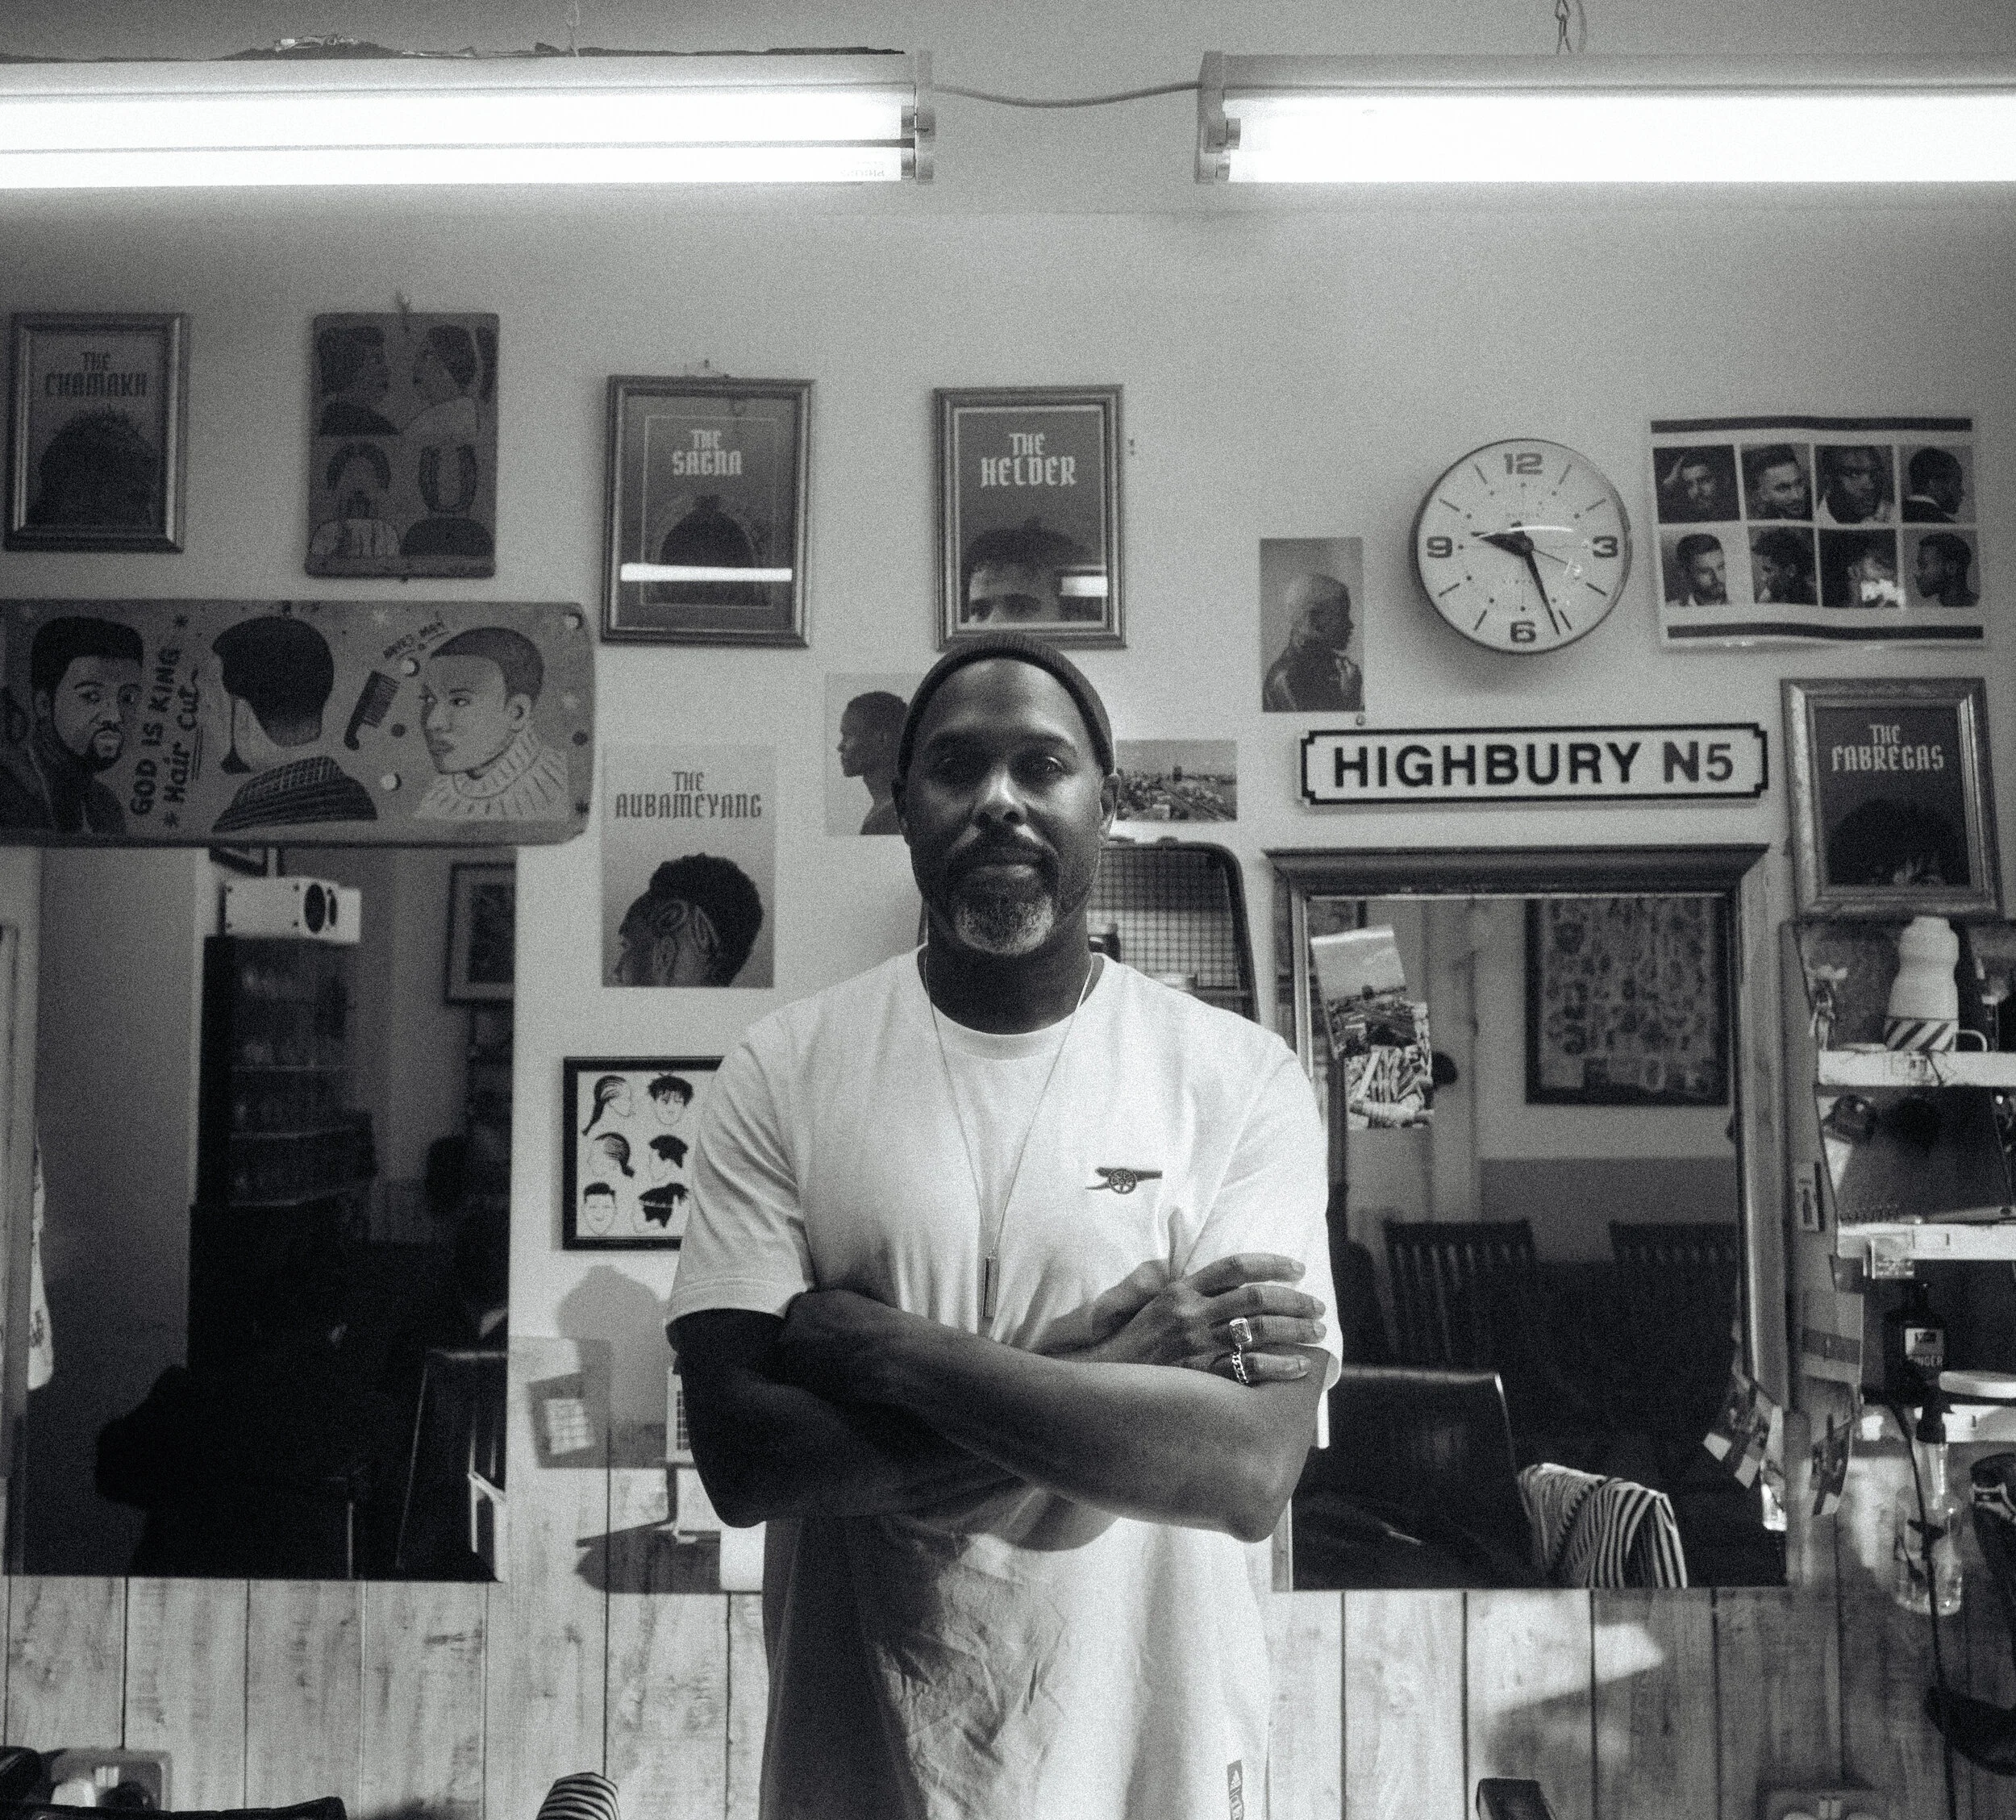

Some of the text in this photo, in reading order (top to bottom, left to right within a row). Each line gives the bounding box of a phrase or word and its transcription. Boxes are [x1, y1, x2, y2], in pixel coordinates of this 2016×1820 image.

[81, 351, 110, 371] THE
[691, 429, 722, 449] THE
[1009, 432, 1045, 456] THE
[672, 450, 742, 475] SAGNA
[980, 456, 1077, 487] HELDER
[1503, 452, 1543, 475] 12
[1427, 536, 1452, 559] 9
[1593, 535, 1618, 559] 3
[1510, 620, 1536, 643] 6
[129, 647, 181, 816] GOD IS KING
[1869, 725, 1901, 743] THE
[1334, 740, 1734, 788] HIGHBURY N5
[1831, 745, 1944, 771] FABREGAS
[162, 741, 190, 803] Hair
[672, 771, 704, 792] THE
[615, 793, 762, 818] AUBAMEYANG
